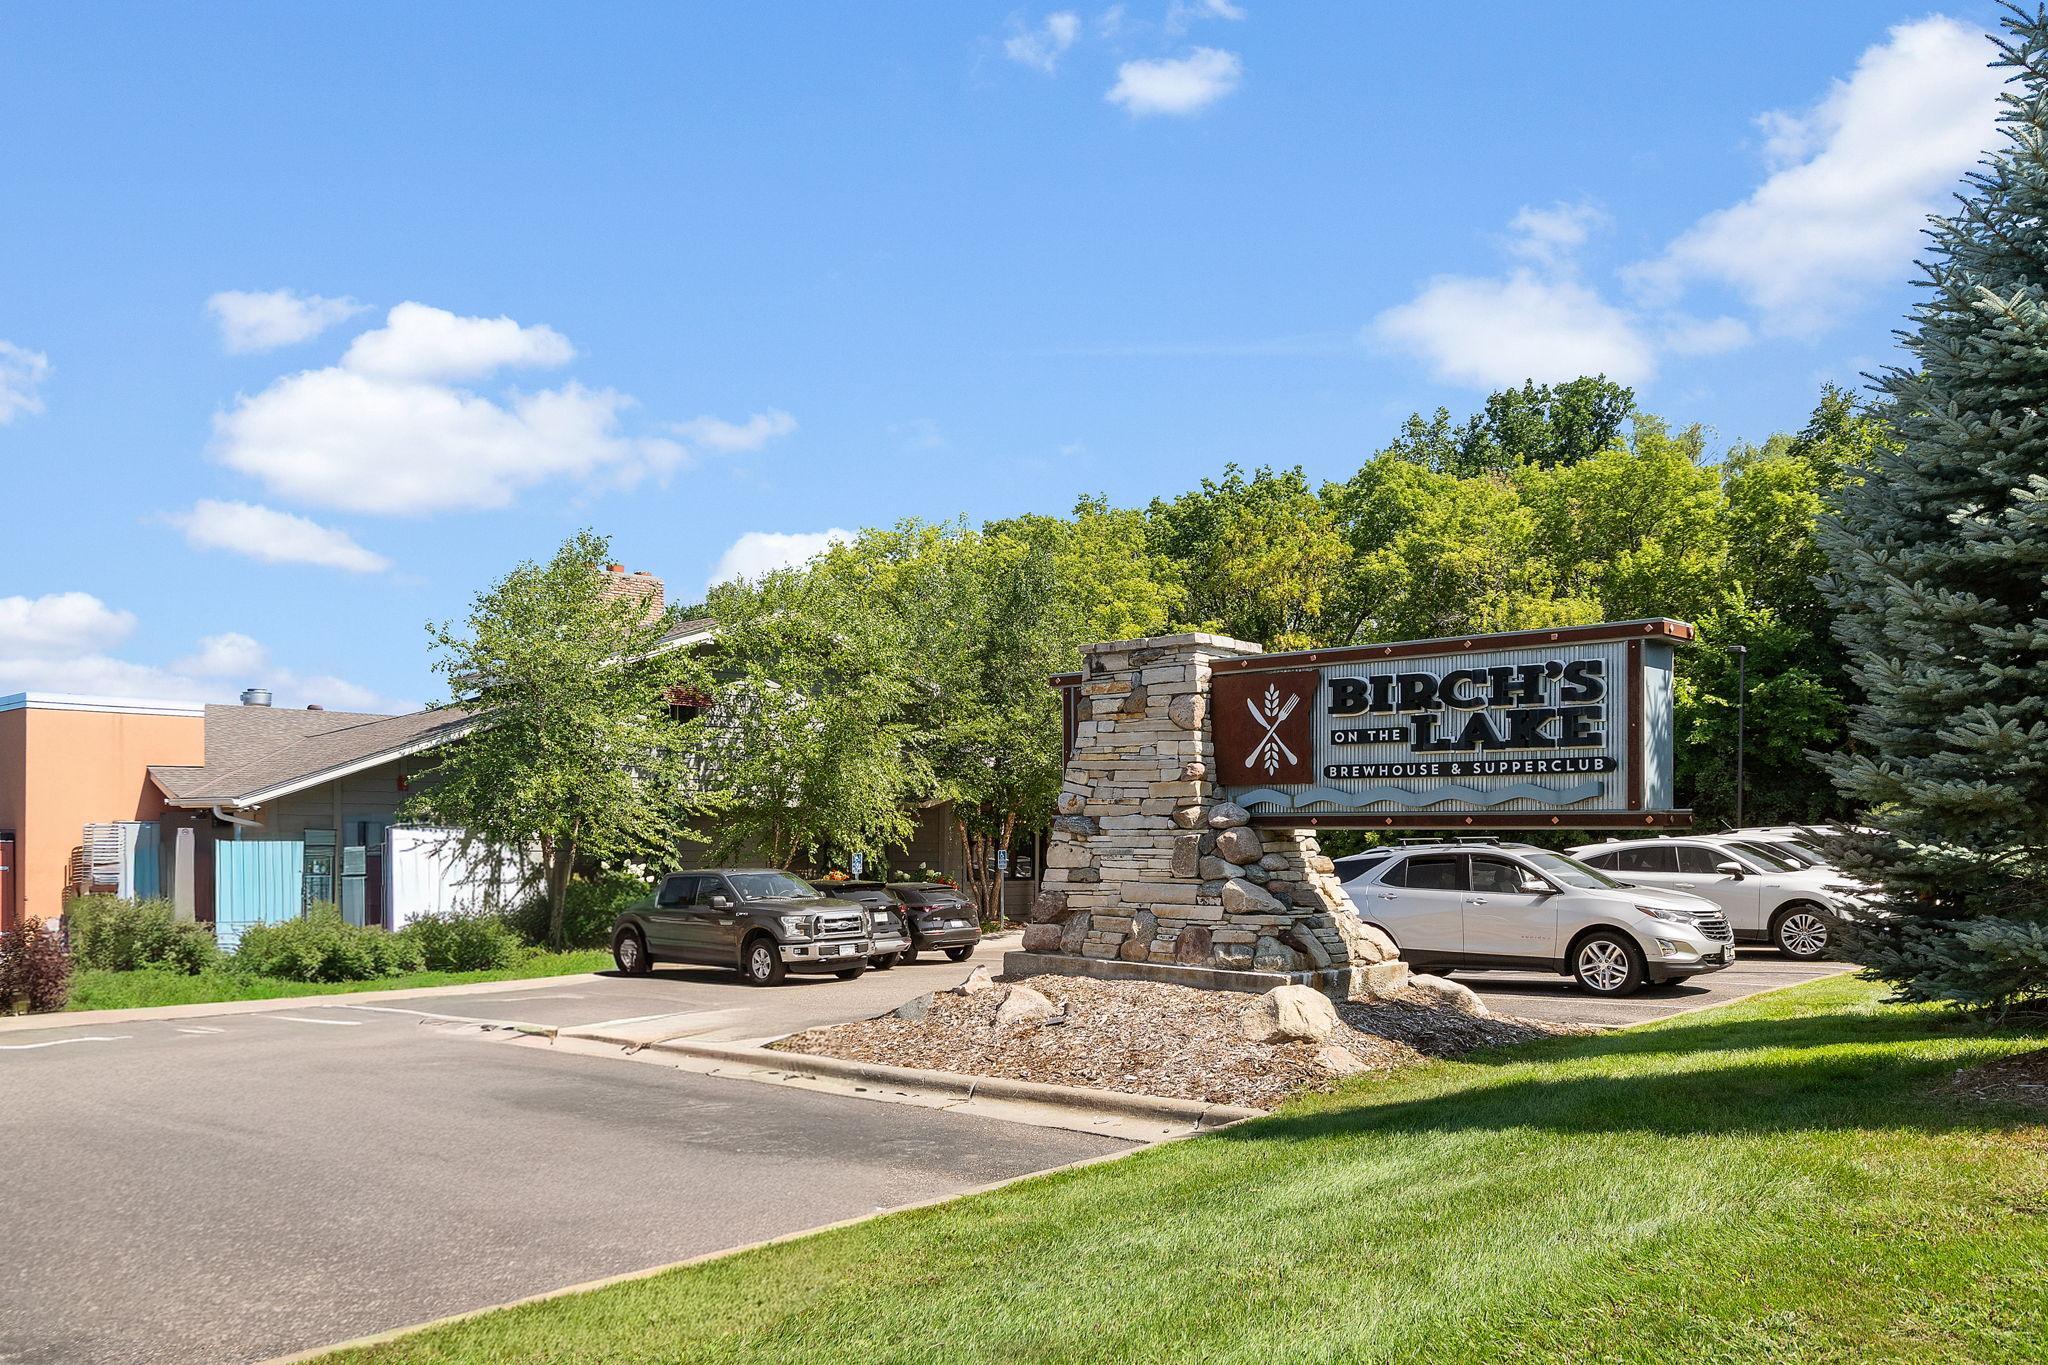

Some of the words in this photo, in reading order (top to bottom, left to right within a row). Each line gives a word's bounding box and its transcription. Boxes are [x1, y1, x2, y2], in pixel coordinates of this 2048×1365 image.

[1328, 658, 1606, 716] BIRCH'S
[1334, 731, 1358, 743] ON
[1367, 729, 1401, 741] THE
[1410, 706, 1605, 753] LAKE
[1329, 763, 1439, 777] BREWHOUSE
[1451, 763, 1461, 774] &
[1473, 758, 1604, 774] SUPPERCLUB
